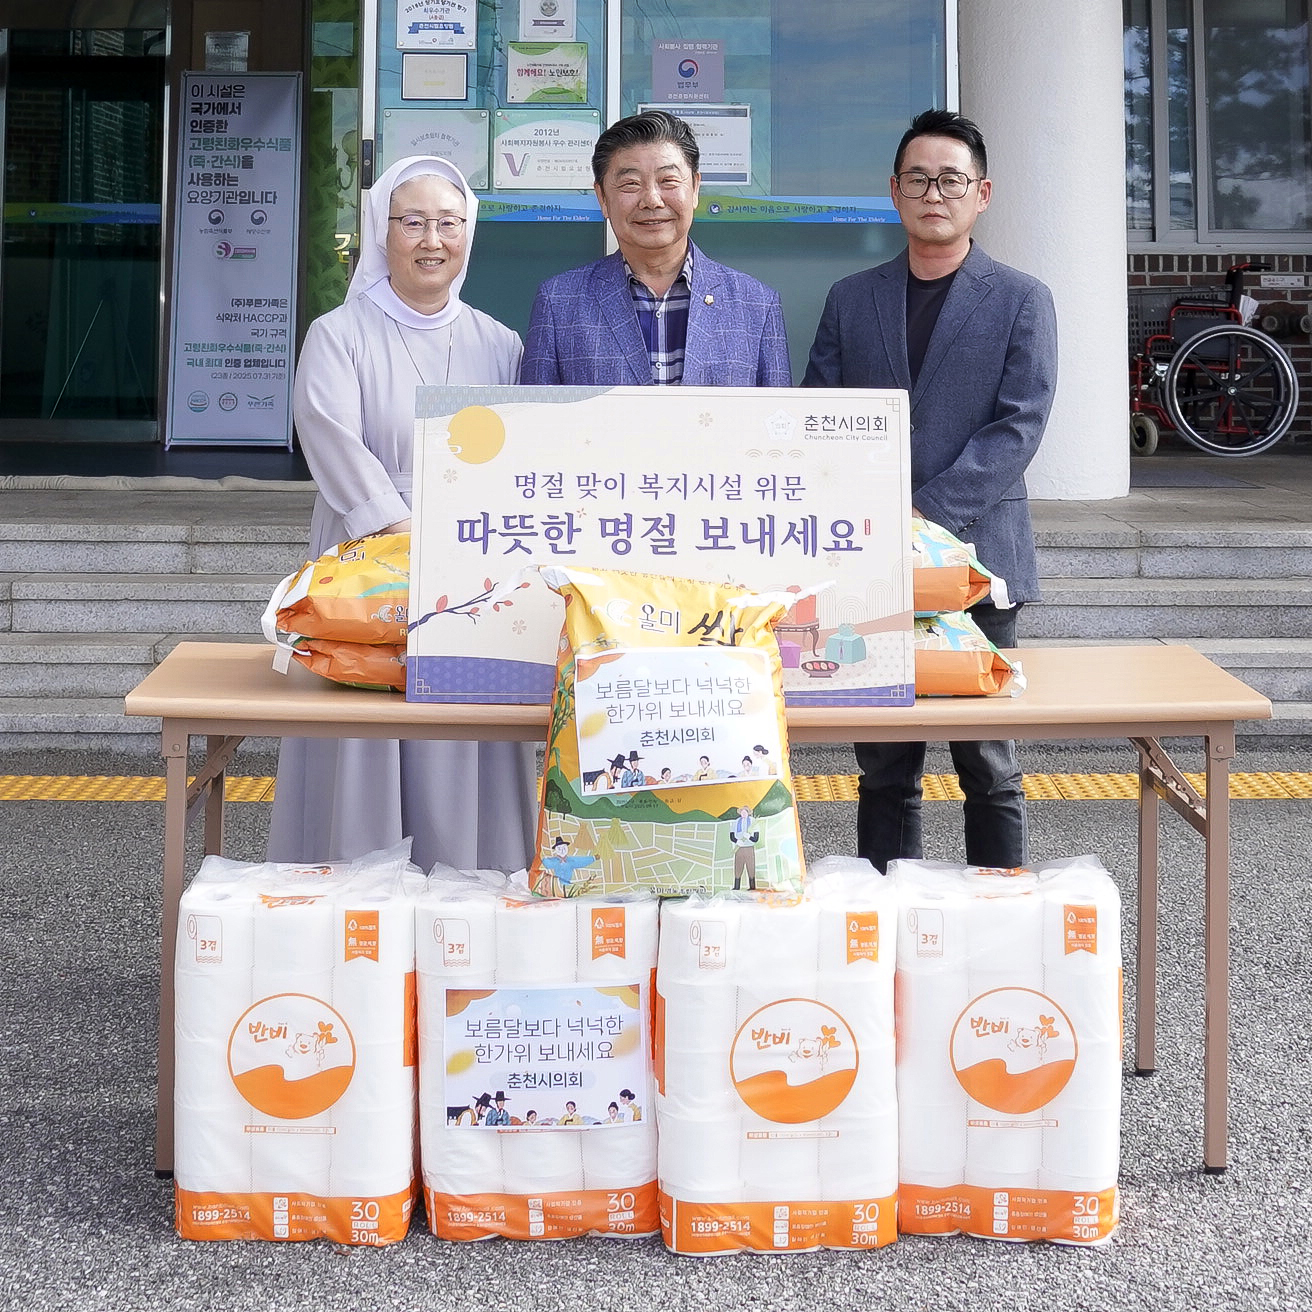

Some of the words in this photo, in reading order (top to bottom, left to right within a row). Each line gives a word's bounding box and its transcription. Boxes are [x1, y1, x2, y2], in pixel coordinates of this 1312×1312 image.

[191, 84, 204, 98] 이
[208, 84, 245, 98] 시설은
[677, 81, 699, 89] 법무부
[190, 102, 242, 115] 국가에서
[190, 120, 228, 134] 인증한
[534, 128, 560, 136] 2012년
[189, 137, 292, 151] 고령친화우수식품
[501, 139, 551, 147] 사회복지자원봉사
[553, 139, 566, 147] 우수
[567, 139, 593, 147] 관리센터
[188, 173, 239, 186] 사용하는
[187, 191, 278, 205] 요양기관입니다
[498, 204, 529, 212] 사랑하고
[726, 205, 757, 214] 감사하는
[760, 205, 790, 214] 마음으로
[793, 205, 823, 214] 사랑하고
[216, 313, 242, 323] 식약처
[243, 313, 288, 323] HACCP과
[270, 329, 287, 338] 규격
[244, 358, 286, 368] 업체입니다
[804, 415, 888, 432] 춘천시의회
[514, 472, 566, 501] 명절
[575, 472, 626, 501] 맞이
[637, 472, 744, 502] 복지시설
[754, 472, 807, 502] 위문
[457, 511, 582, 556] 따뜻한
[598, 513, 678, 556] 명절
[695, 514, 863, 558] 보내세요
[639, 604, 680, 635] 올미
[596, 680, 690, 700] 보름달보다
[695, 677, 751, 695] 넉넉한
[605, 701, 662, 723] 한가위
[669, 698, 745, 719] 보내세요
[639, 728, 715, 747] 춘천시의회
[200, 939, 217, 951] 3겹
[921, 933, 938, 945] 3겹
[447, 942, 465, 955] 3겹
[704, 945, 720, 957] 3겹
[248, 1021, 288, 1043] 반비
[465, 1018, 560, 1039] 보름달보다
[567, 1015, 624, 1036] 넉넉한
[970, 1015, 1009, 1037] 반비
[751, 1026, 790, 1049] 반비
[474, 1043, 531, 1064] 한가위
[538, 1041, 614, 1062] 보내세요
[507, 1071, 583, 1089] 춘천시의회
[607, 1193, 635, 1212] 30
[1072, 1196, 1099, 1215] 30
[192, 1209, 250, 1221] 1899-2514
[351, 1202, 379, 1220] 30
[852, 1204, 879, 1222] 30
[915, 1203, 971, 1216] 1899-2514
[448, 1212, 505, 1222] 1899-2514
[691, 1221, 751, 1232] 1899-2514
[1073, 1226, 1098, 1238] 30m
[351, 1231, 379, 1242] 30m
[851, 1233, 877, 1245] 30m
